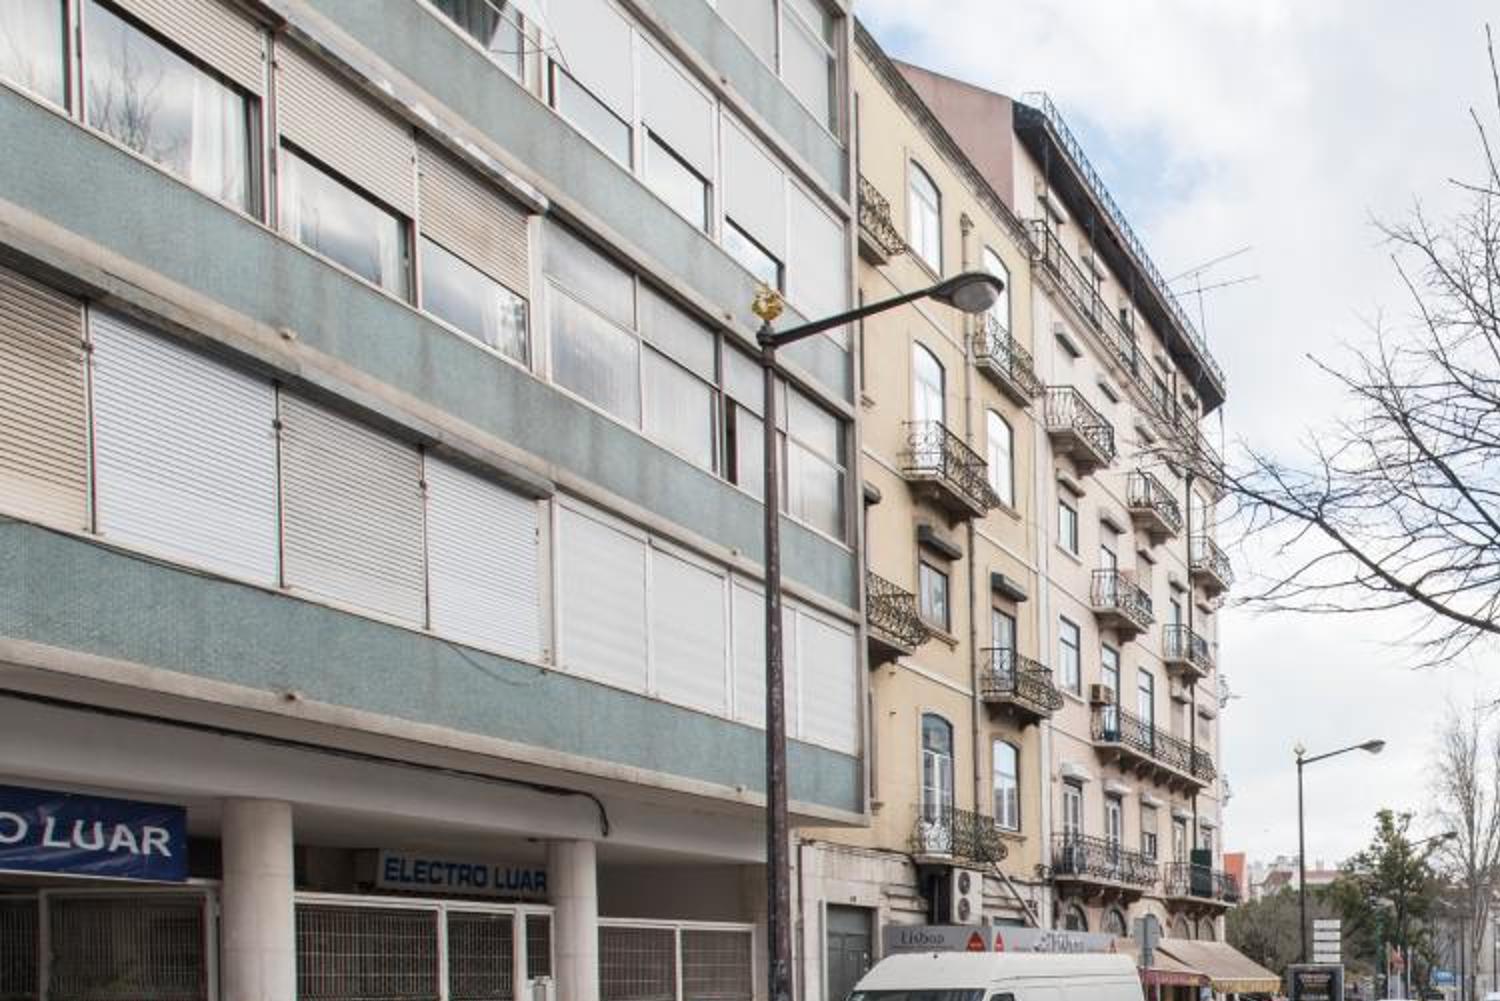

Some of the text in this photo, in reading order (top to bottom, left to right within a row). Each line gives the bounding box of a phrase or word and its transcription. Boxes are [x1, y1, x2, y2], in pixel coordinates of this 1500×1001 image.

[42, 816, 172, 857] LUAR
[384, 857, 547, 892] ELECTRO LUAR
